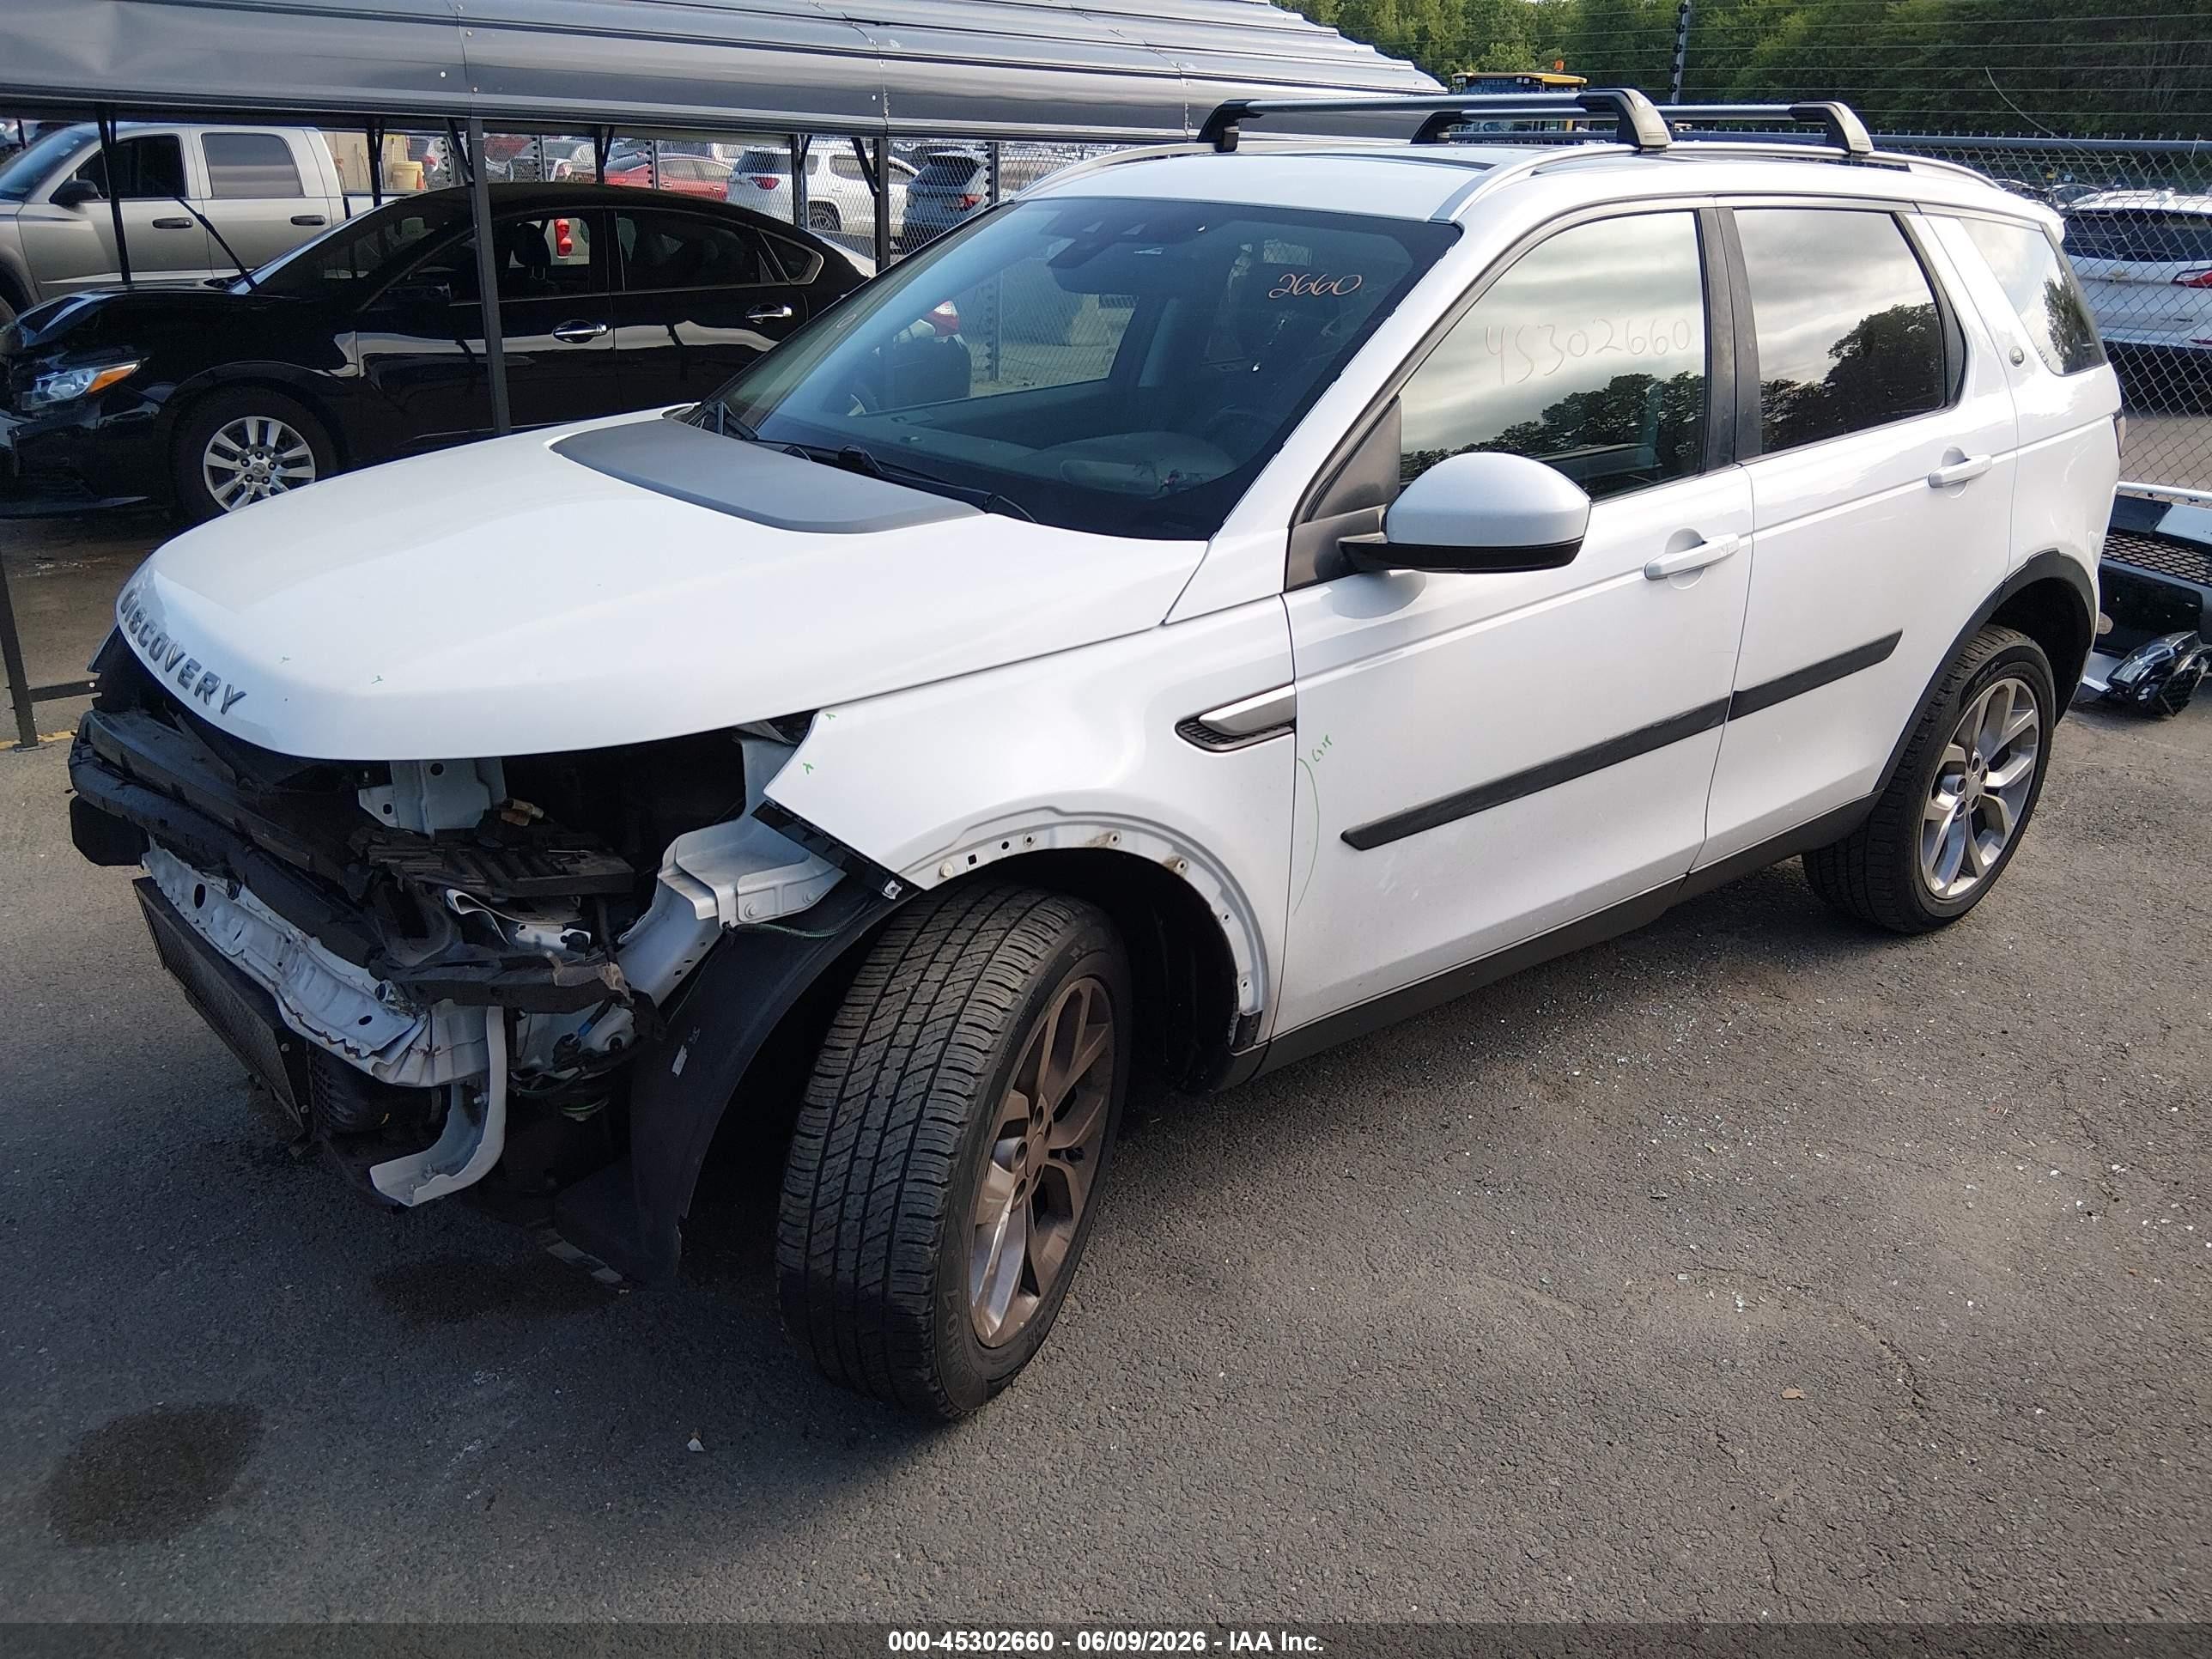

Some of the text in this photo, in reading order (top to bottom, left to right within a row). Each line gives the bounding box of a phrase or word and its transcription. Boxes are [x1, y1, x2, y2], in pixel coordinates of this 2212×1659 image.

[1268, 273, 1363, 299] 2660
[1486, 318, 1692, 386] 45302660
[120, 588, 247, 715] DISCOVERY
